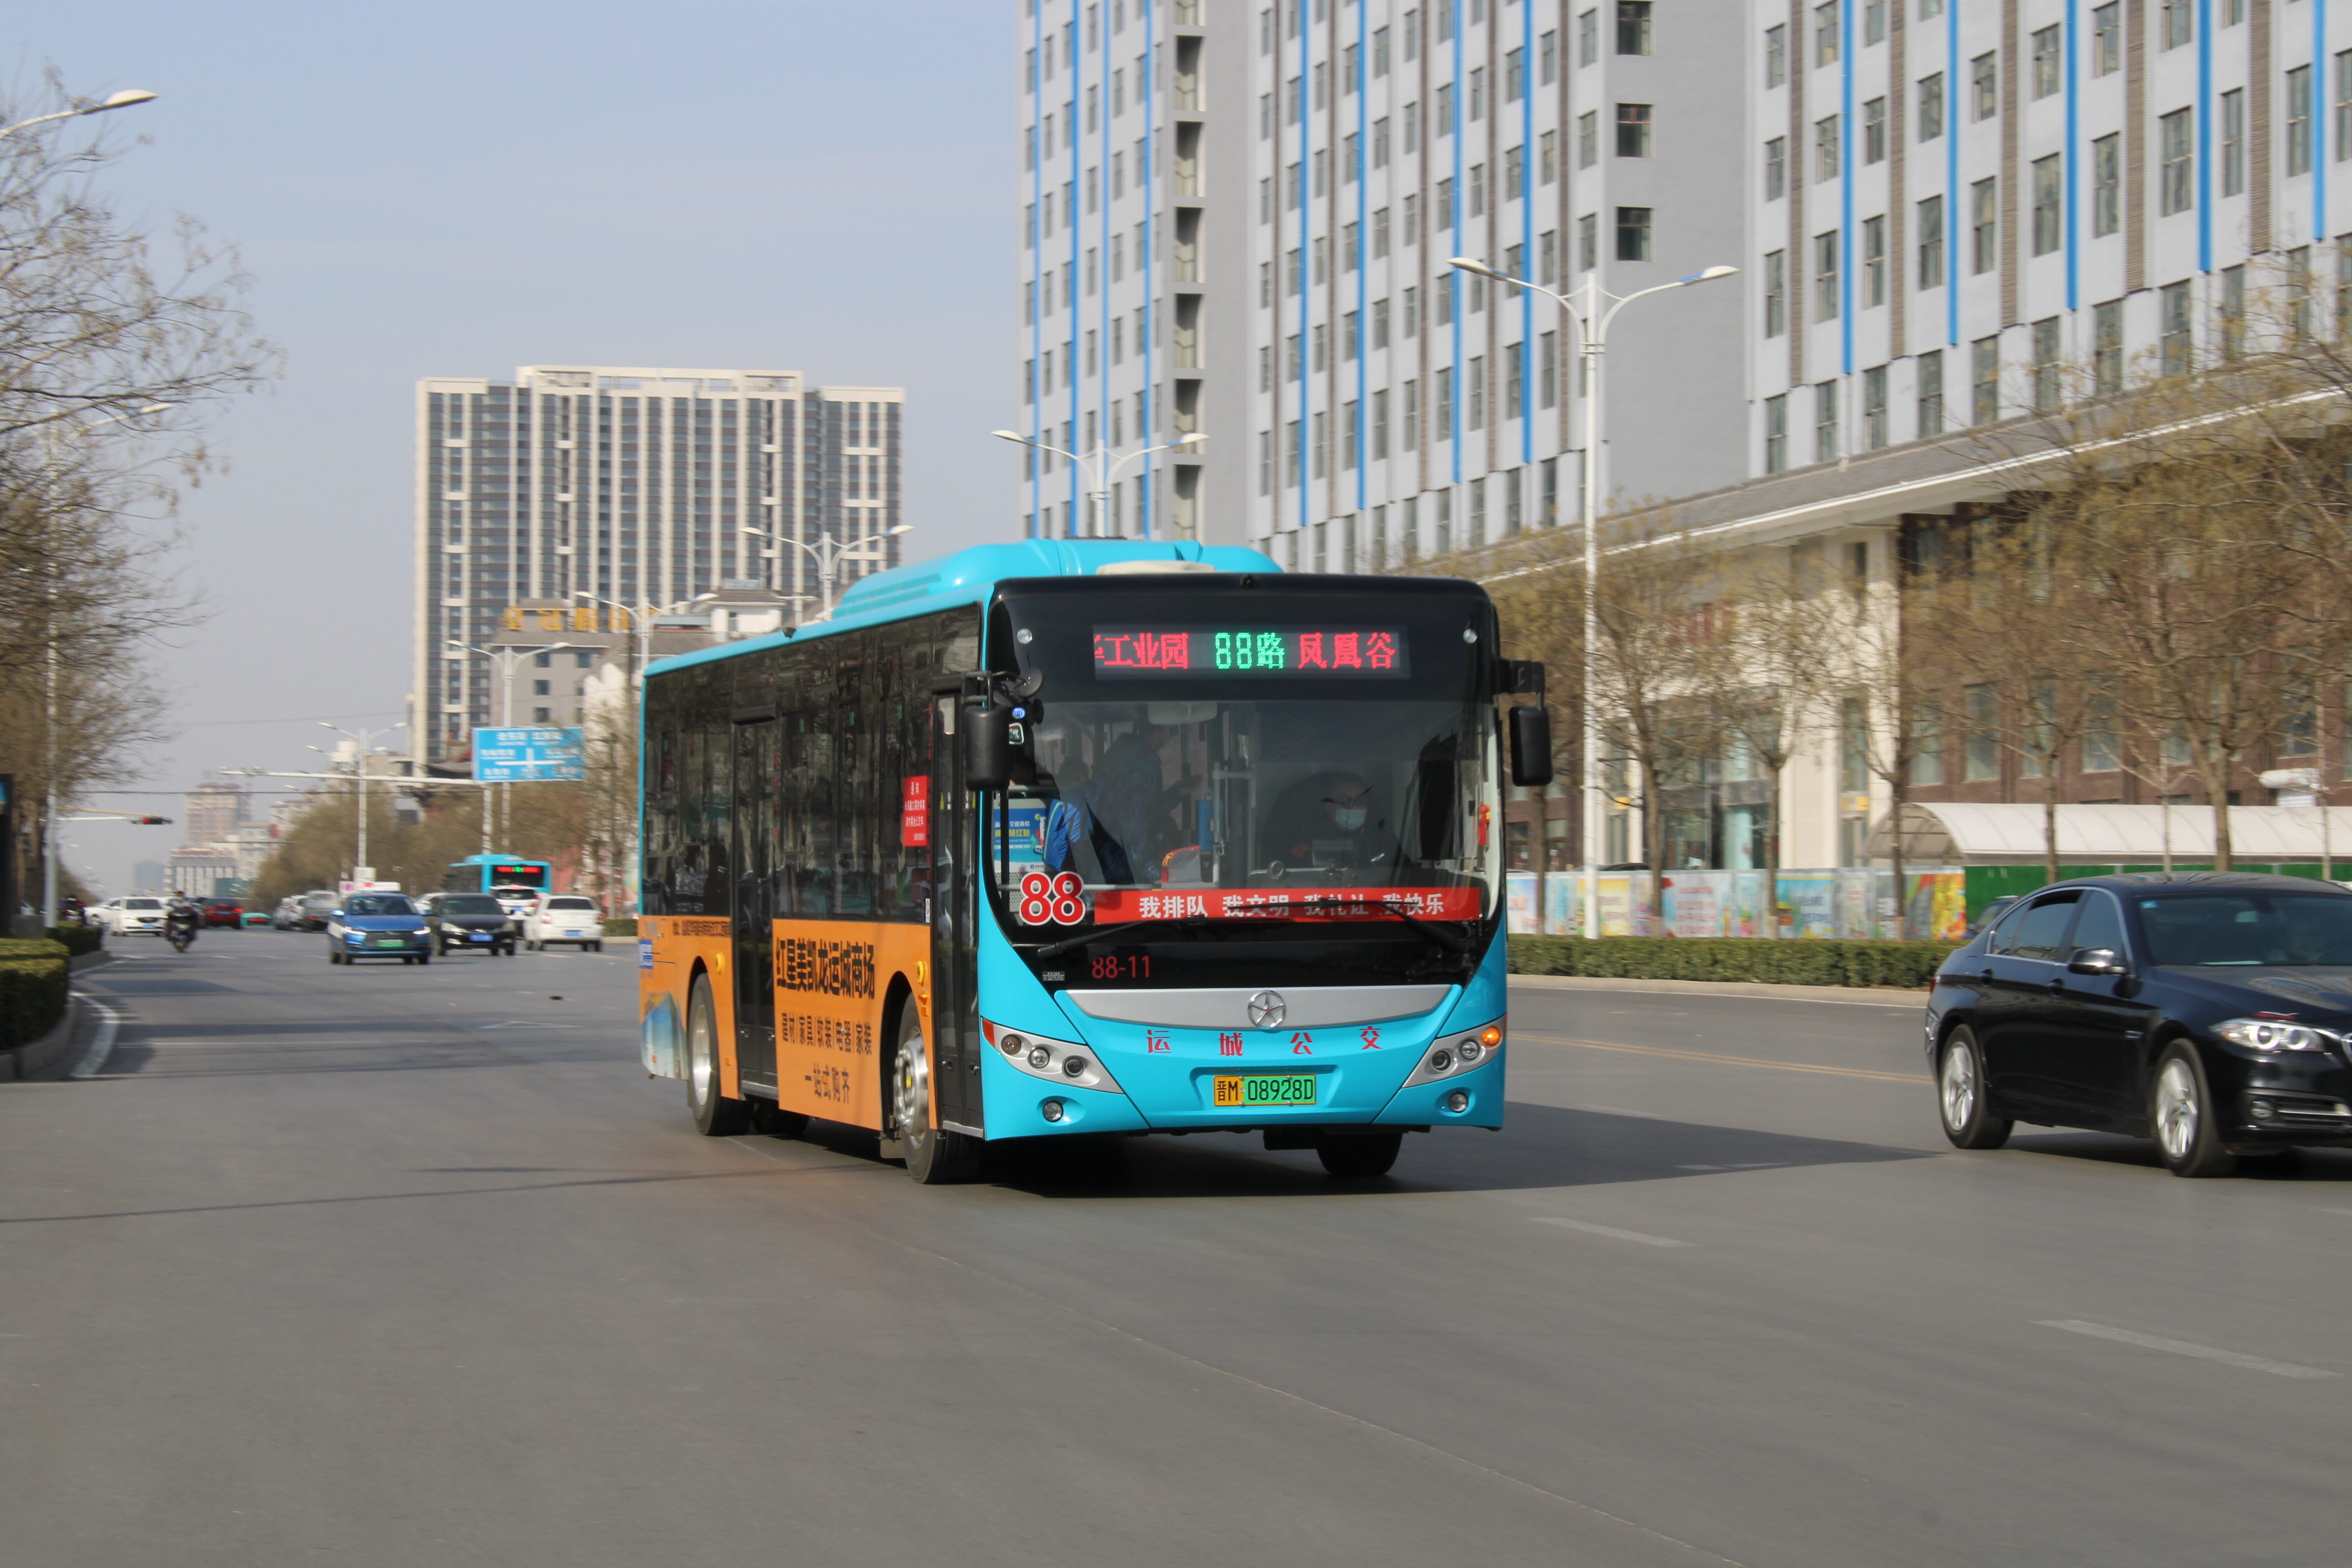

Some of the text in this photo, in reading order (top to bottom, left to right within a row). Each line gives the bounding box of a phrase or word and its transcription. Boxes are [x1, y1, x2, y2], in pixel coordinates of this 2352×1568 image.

[1215, 632, 1285, 669] 88路
[1298, 632, 1396, 669] 凤凰谷
[1020, 871, 1085, 926] 88
[1139, 895, 1208, 919] 我排队
[1223, 894, 1289, 917] 我文明
[1383, 893, 1445, 915] 我快乐
[776, 936, 875, 999] 红星美凯龙运城商场
[1092, 956, 1150, 979] 88-11
[1146, 1026, 1383, 1057] 运城公交
